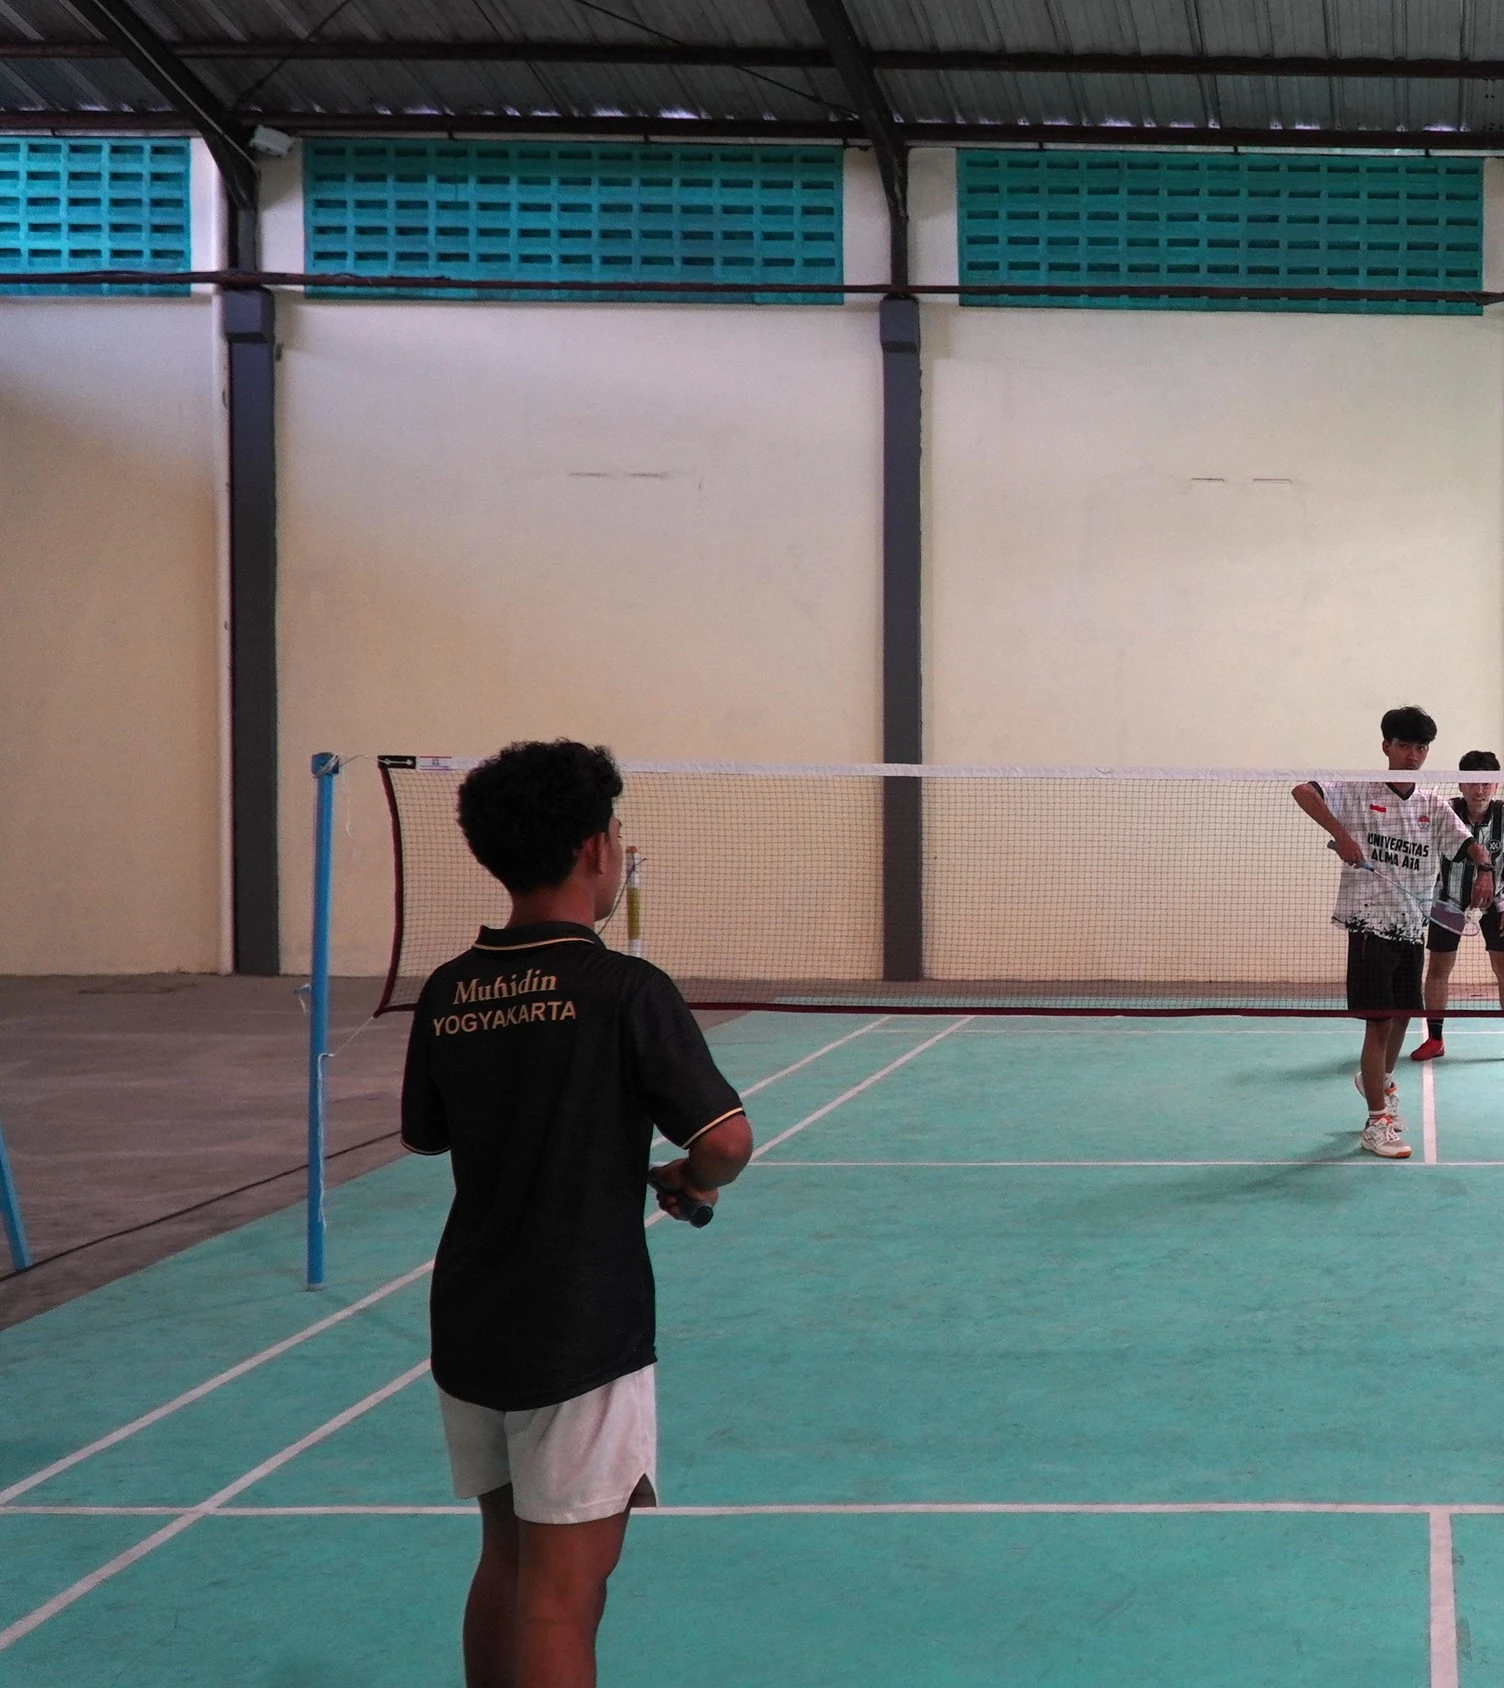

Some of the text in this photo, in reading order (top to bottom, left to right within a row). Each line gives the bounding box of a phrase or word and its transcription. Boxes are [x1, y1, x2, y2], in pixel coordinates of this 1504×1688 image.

[1367, 832, 1430, 858] UNIVERSITAS
[1371, 848, 1420, 872] ALMA ATA
[452, 968, 557, 1005] Muhidin
[433, 1001, 577, 1037] YOGYAKARTA
